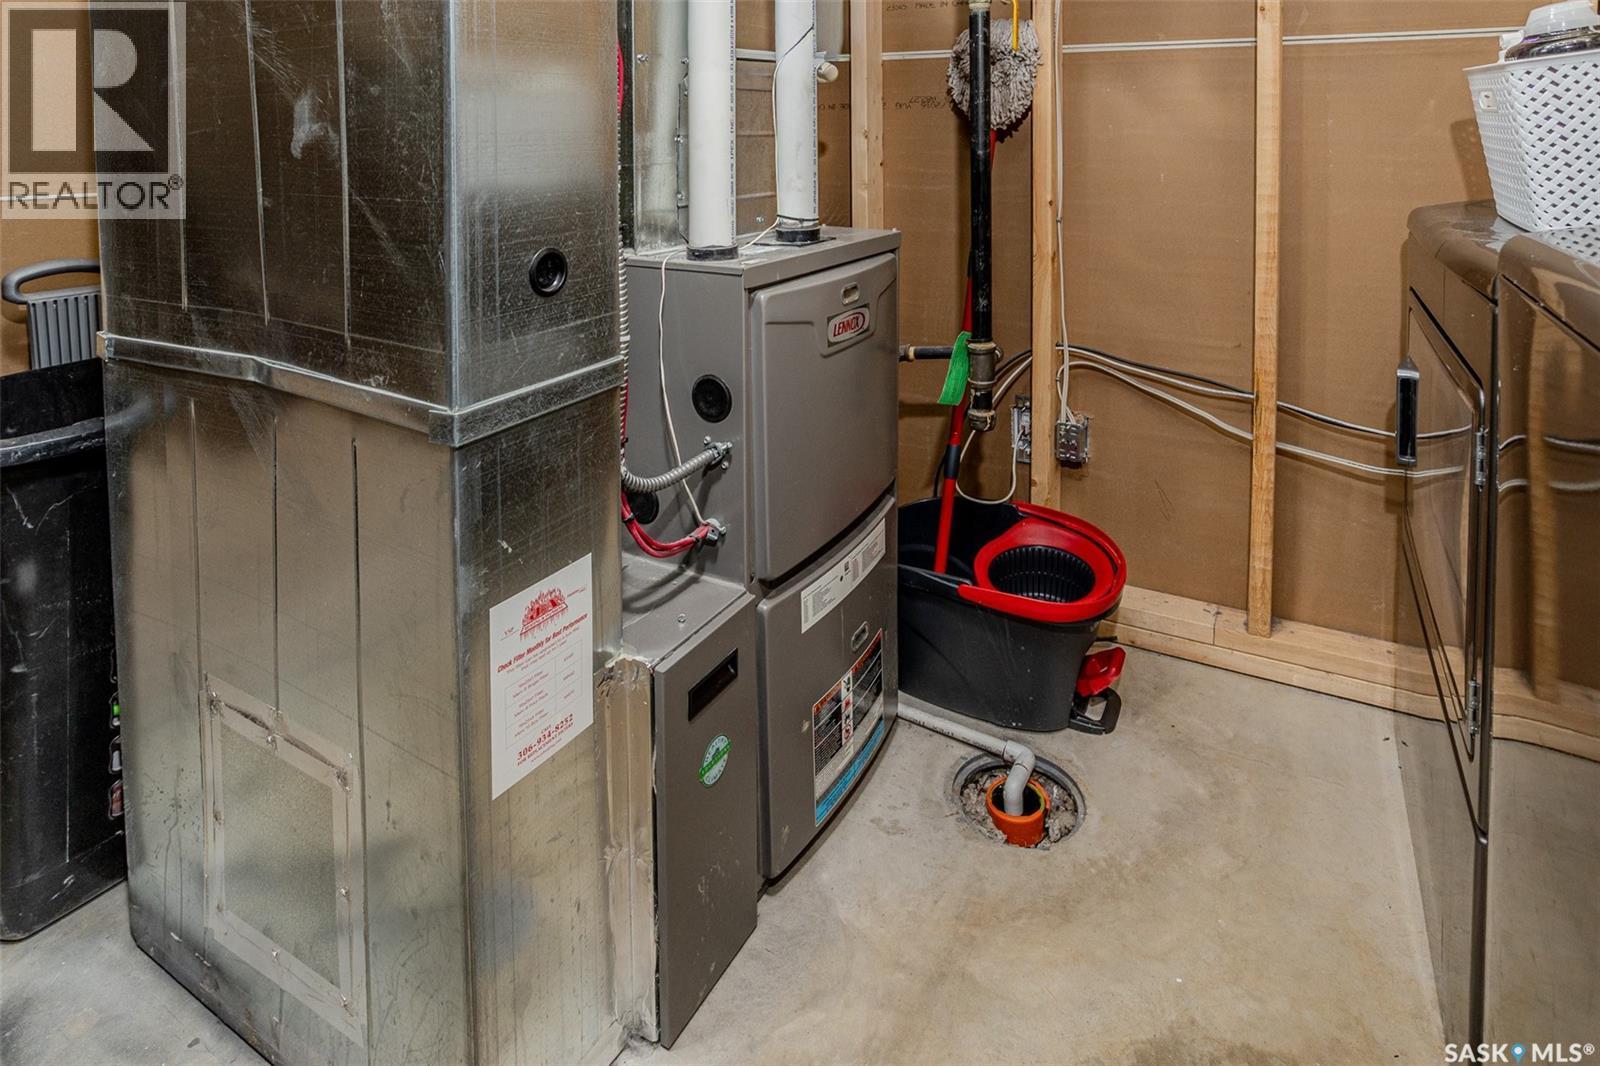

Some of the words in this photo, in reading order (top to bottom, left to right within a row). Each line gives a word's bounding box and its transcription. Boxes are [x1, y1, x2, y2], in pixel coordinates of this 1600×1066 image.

[833, 315, 859, 337] LENNOX
[497, 659, 512, 673] Check
[526, 639, 544, 656] Monthly
[516, 713, 573, 760] 306-934-8252
